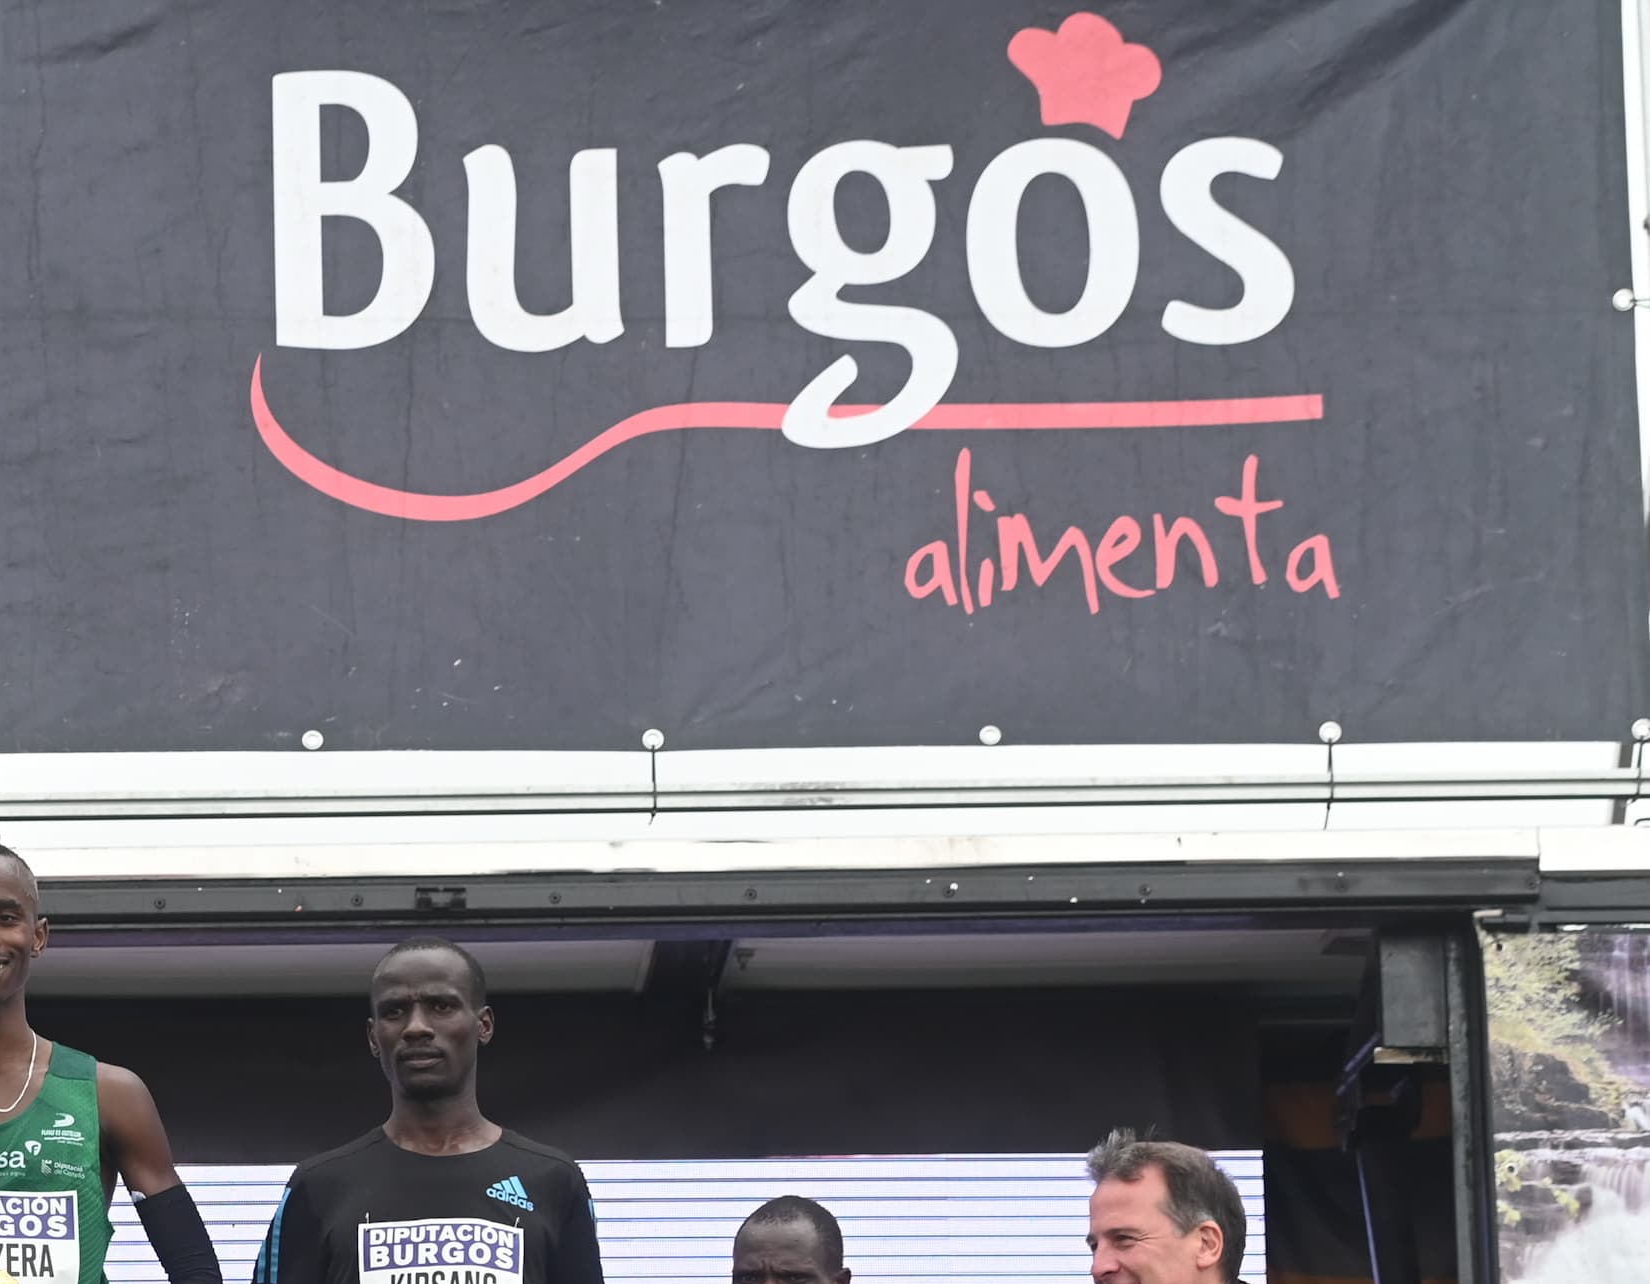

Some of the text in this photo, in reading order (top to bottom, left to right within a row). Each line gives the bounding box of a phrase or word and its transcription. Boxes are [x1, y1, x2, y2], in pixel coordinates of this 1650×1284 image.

[271, 69, 1296, 449] Burgos
[903, 447, 1340, 614] alimenta
[485, 1185, 535, 1212] adidas
[369, 1224, 514, 1249] DIPUTACIÓN
[369, 1241, 514, 1270] BURGOS
